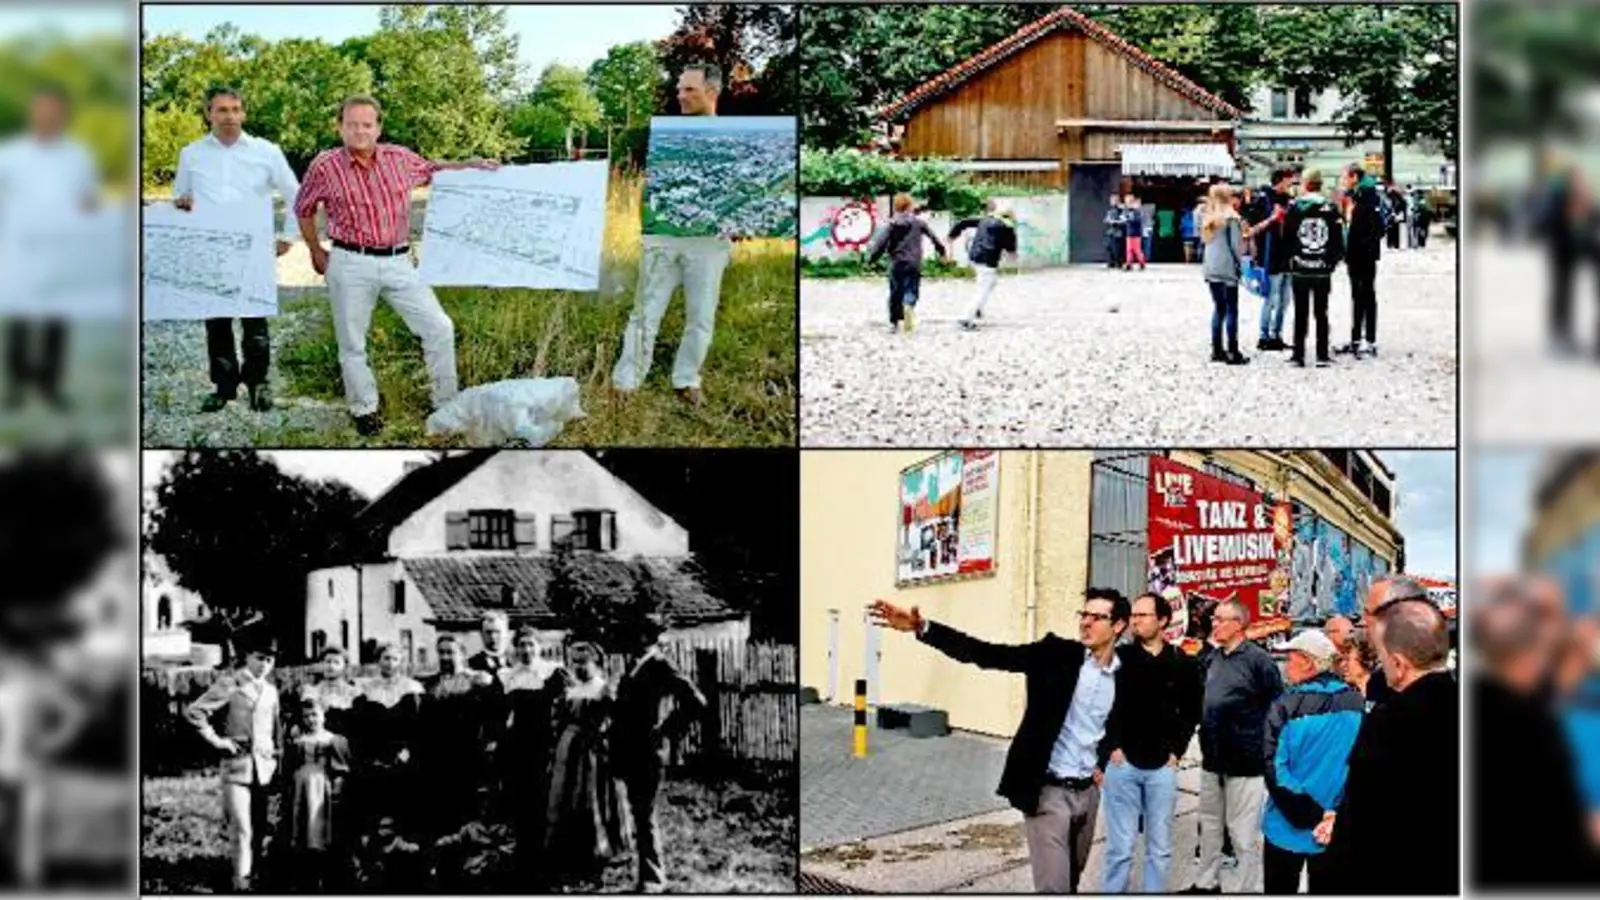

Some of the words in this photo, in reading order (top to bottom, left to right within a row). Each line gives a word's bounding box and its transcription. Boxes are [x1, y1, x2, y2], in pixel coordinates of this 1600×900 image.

[1197, 500, 1247, 529] TANZ
[1253, 503, 1266, 529] &
[1172, 535, 1275, 565] LIVEMUSIK
